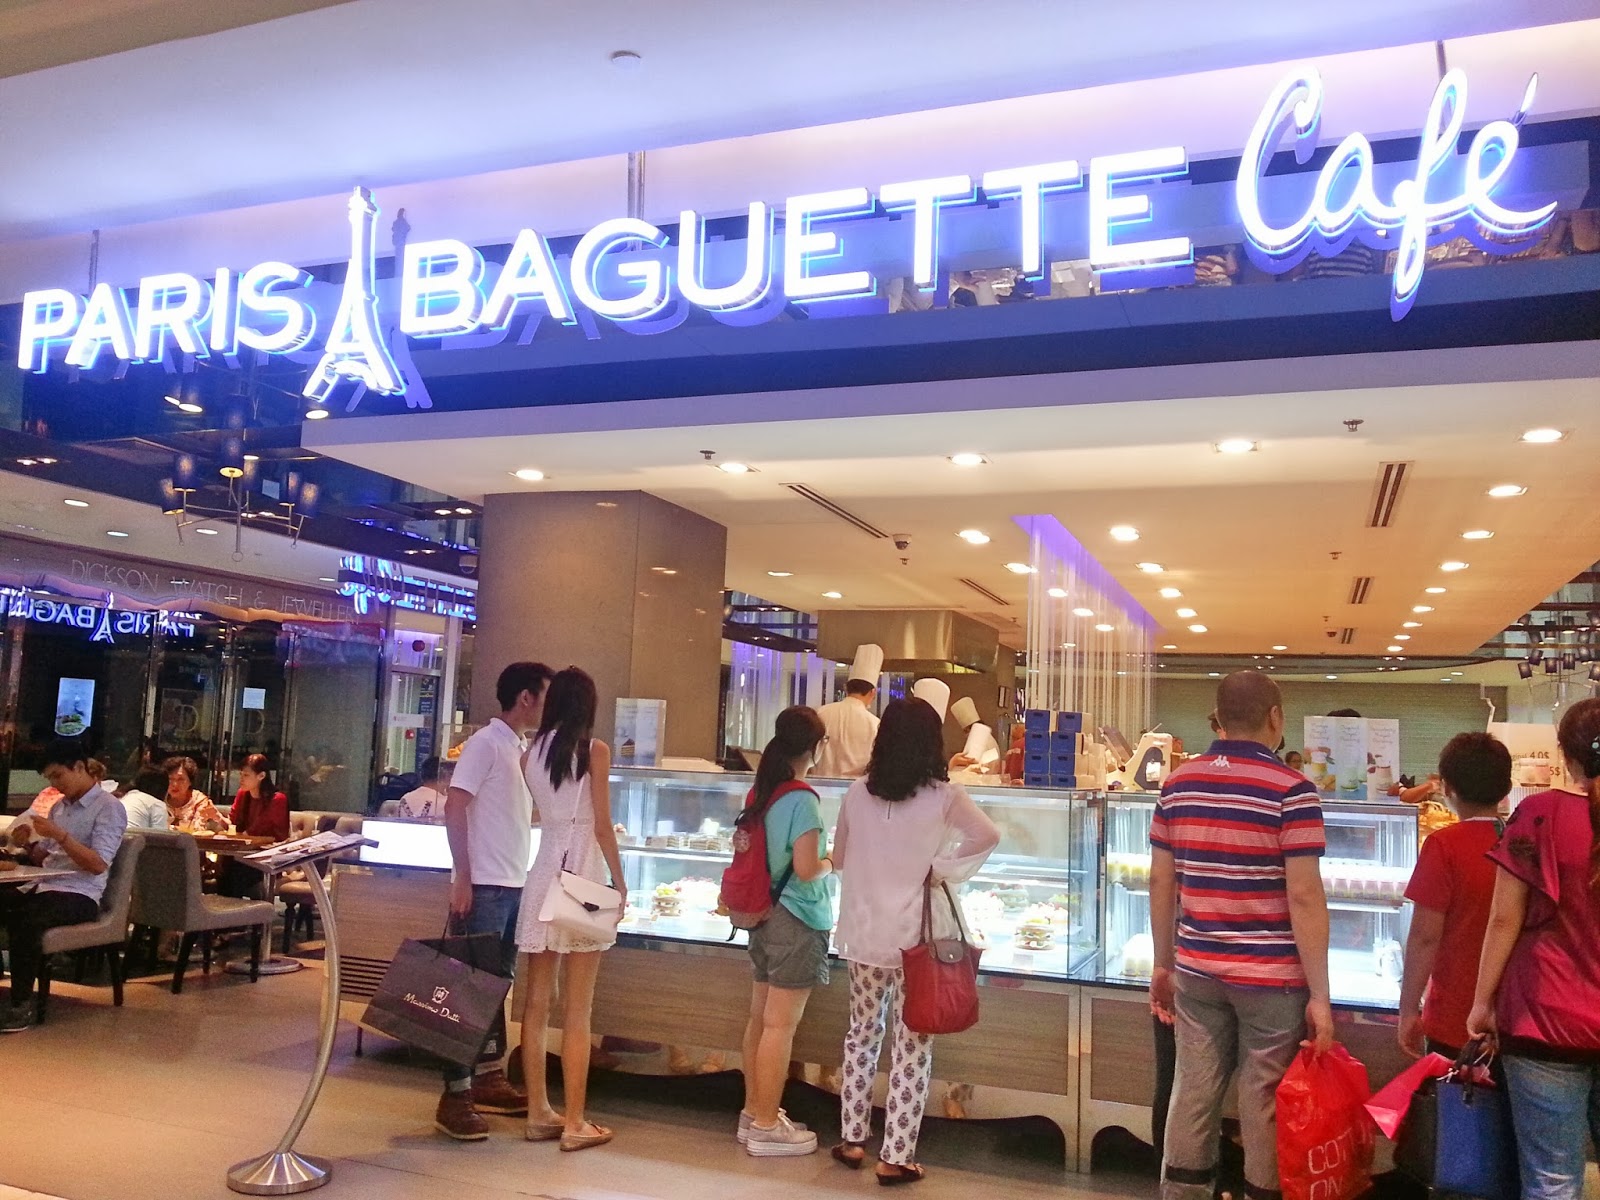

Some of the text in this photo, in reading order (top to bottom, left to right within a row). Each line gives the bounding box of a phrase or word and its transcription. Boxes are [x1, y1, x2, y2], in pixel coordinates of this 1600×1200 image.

[18, 65, 1558, 373] PARIS BAGUETTE Café
[71, 559, 159, 593] DICKSON
[172, 576, 243, 607] WATCH
